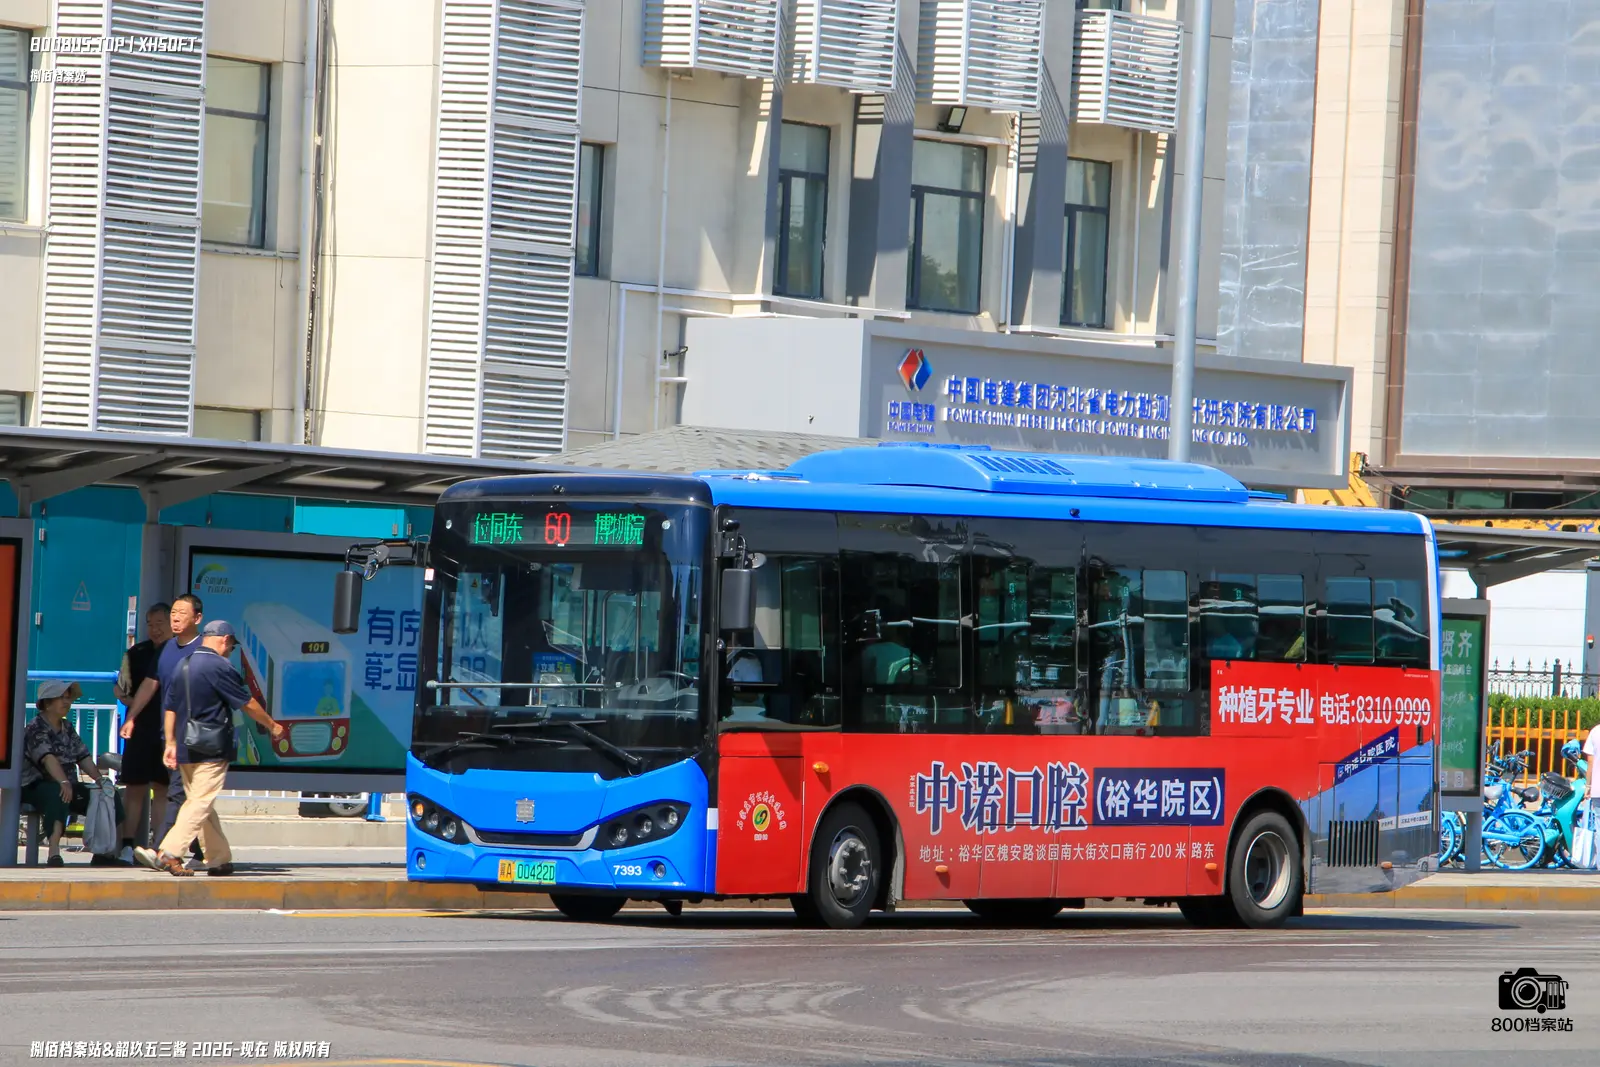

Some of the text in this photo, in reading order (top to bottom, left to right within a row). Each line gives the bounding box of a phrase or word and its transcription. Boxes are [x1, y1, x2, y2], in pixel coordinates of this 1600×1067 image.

[887, 400, 936, 422] 中国电建
[943, 407, 1015, 426] POWERCHINA
[1050, 416, 1100, 434] ELECTRIC
[1101, 420, 1138, 437] POWER
[474, 512, 645, 544] 位同东 60 博物院
[308, 642, 325, 652] 101
[1218, 685, 1314, 724] 种植牙专业
[1320, 692, 1392, 725] 电话:8310
[1395, 697, 1431, 726] 9999
[916, 760, 1222, 835] 中诺口腔 (裕华院区)
[1149, 843, 1173, 859] 200
[1191, 841, 1215, 860] 路东
[613, 864, 643, 876] 7393
